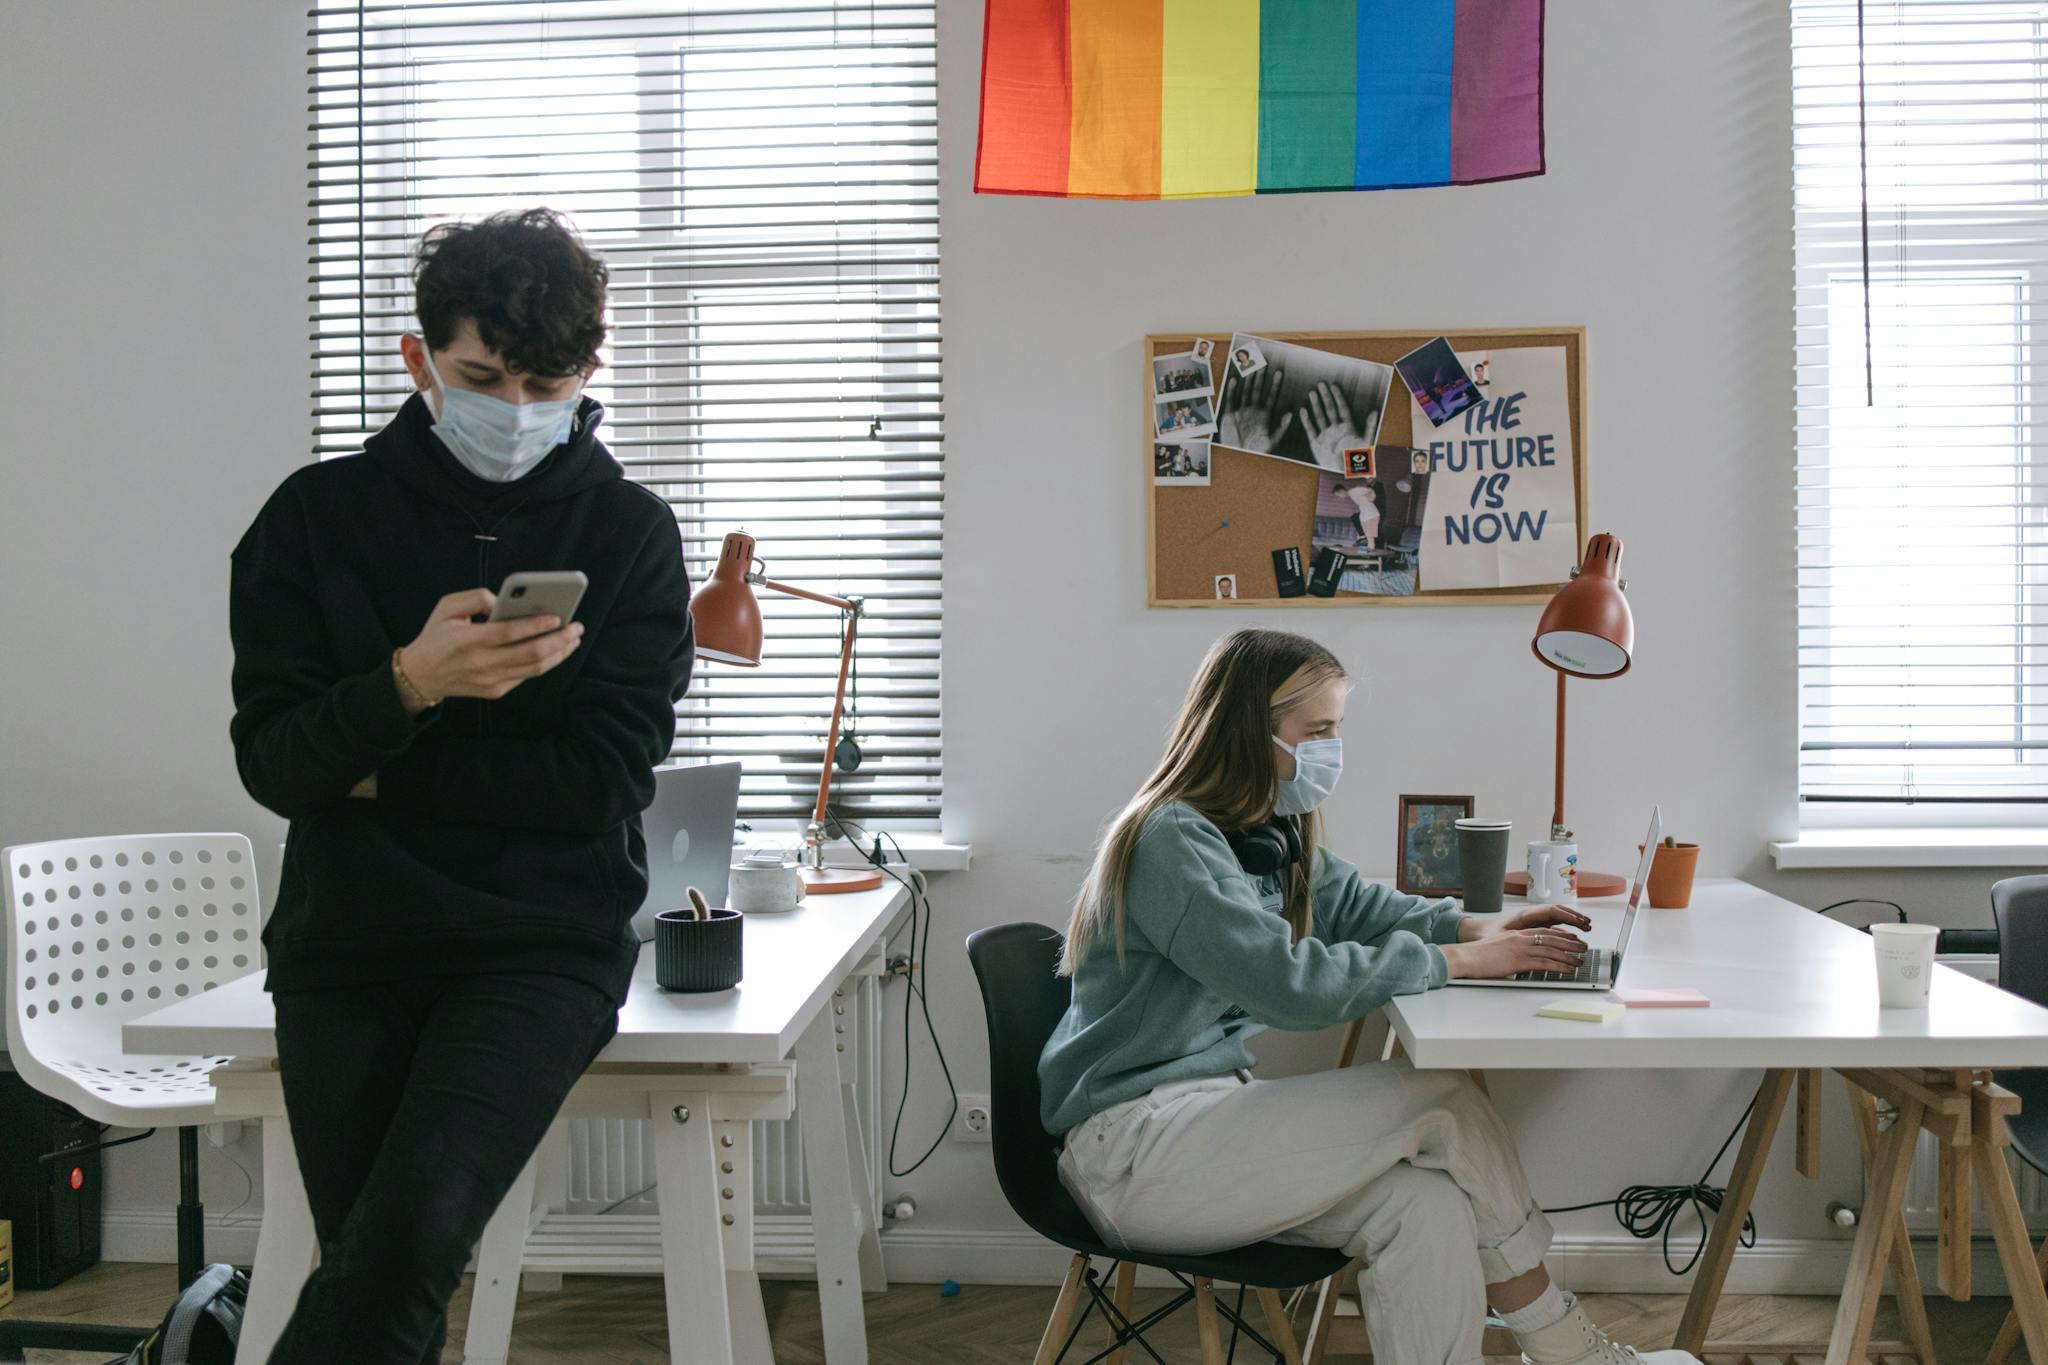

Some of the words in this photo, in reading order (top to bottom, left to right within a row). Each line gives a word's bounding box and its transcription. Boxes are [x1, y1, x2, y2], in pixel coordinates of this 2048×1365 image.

[1464, 391, 1527, 436] THE
[1429, 434, 1556, 472] FUTURE
[1470, 473, 1510, 510] IS
[1444, 510, 1548, 546] NOW
